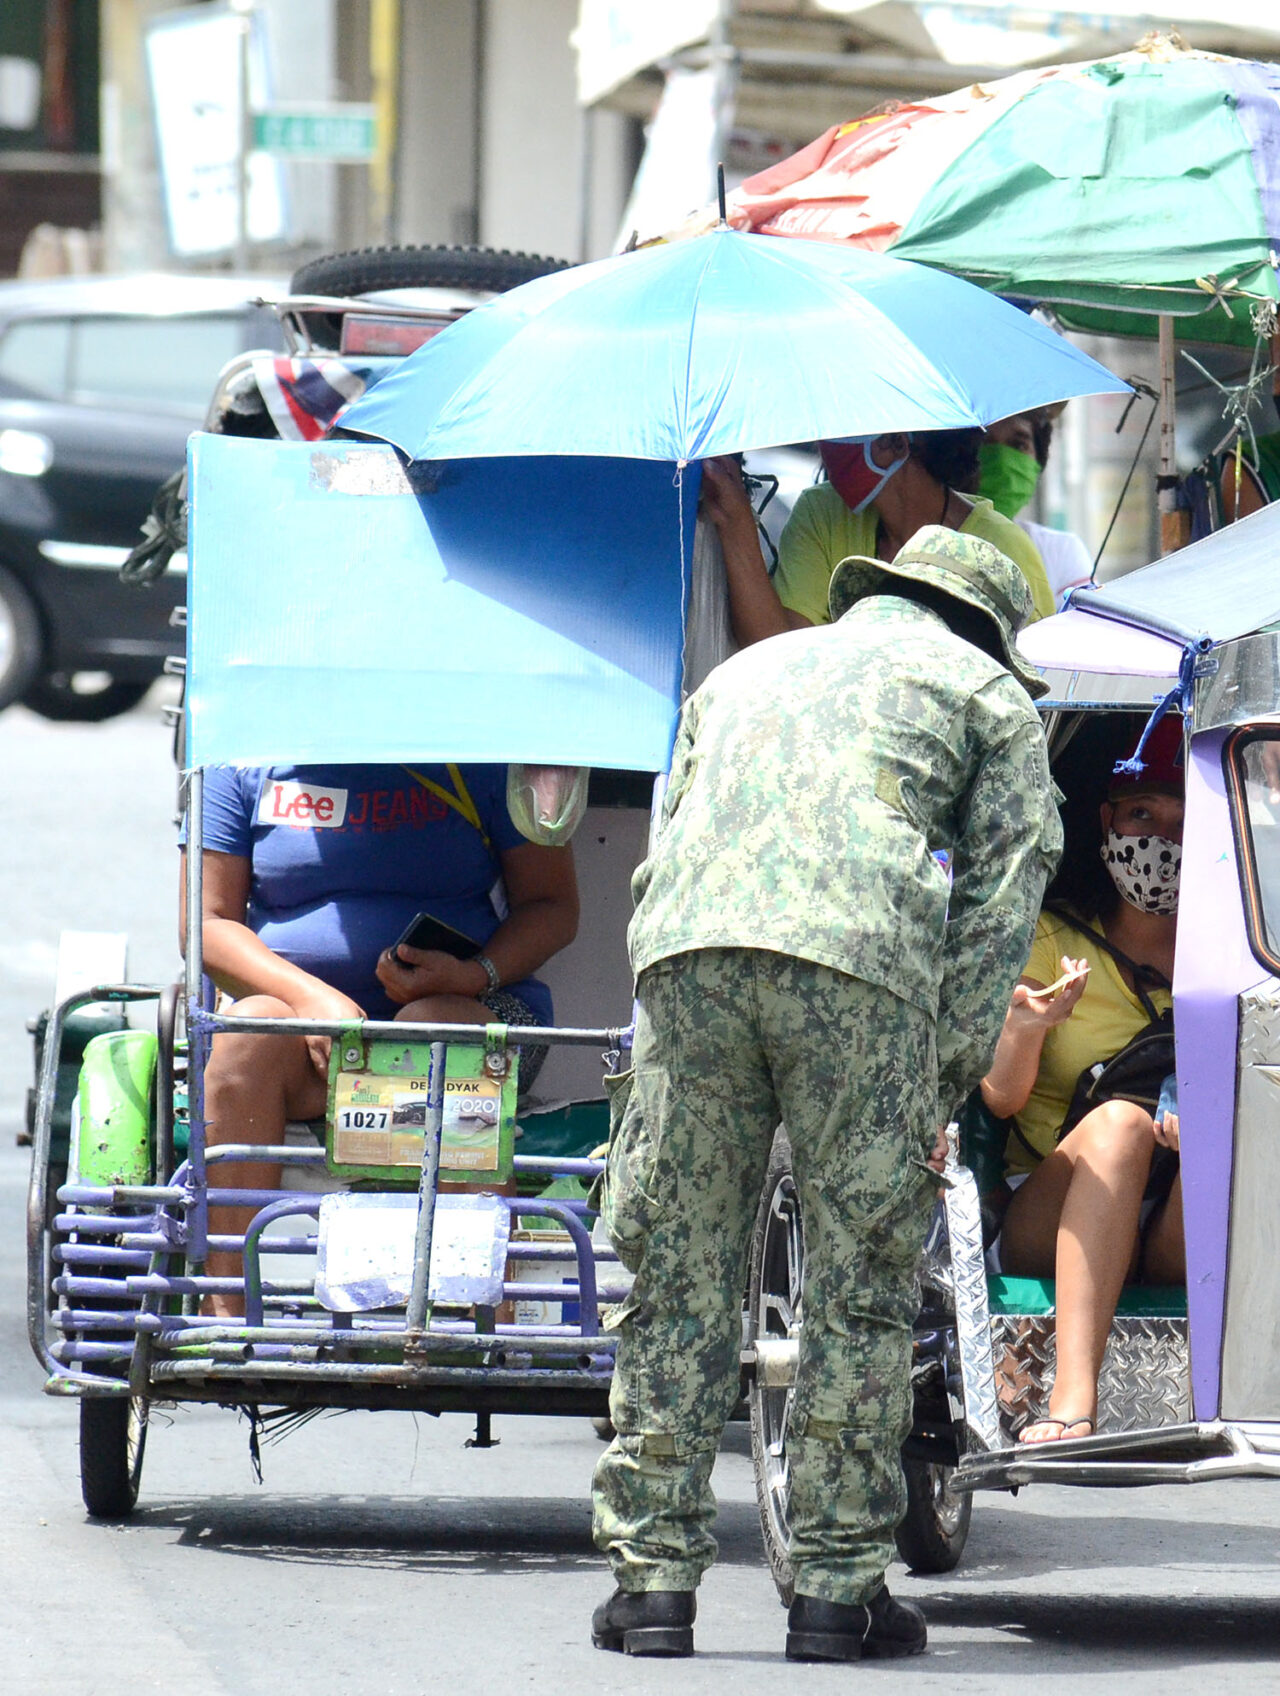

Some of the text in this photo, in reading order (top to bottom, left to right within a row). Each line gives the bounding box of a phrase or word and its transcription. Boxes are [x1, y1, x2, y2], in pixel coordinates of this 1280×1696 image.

[273, 785, 449, 826] Lee JEANS
[453, 1099, 496, 1114] 2020
[343, 1111, 388, 1129] 1027
